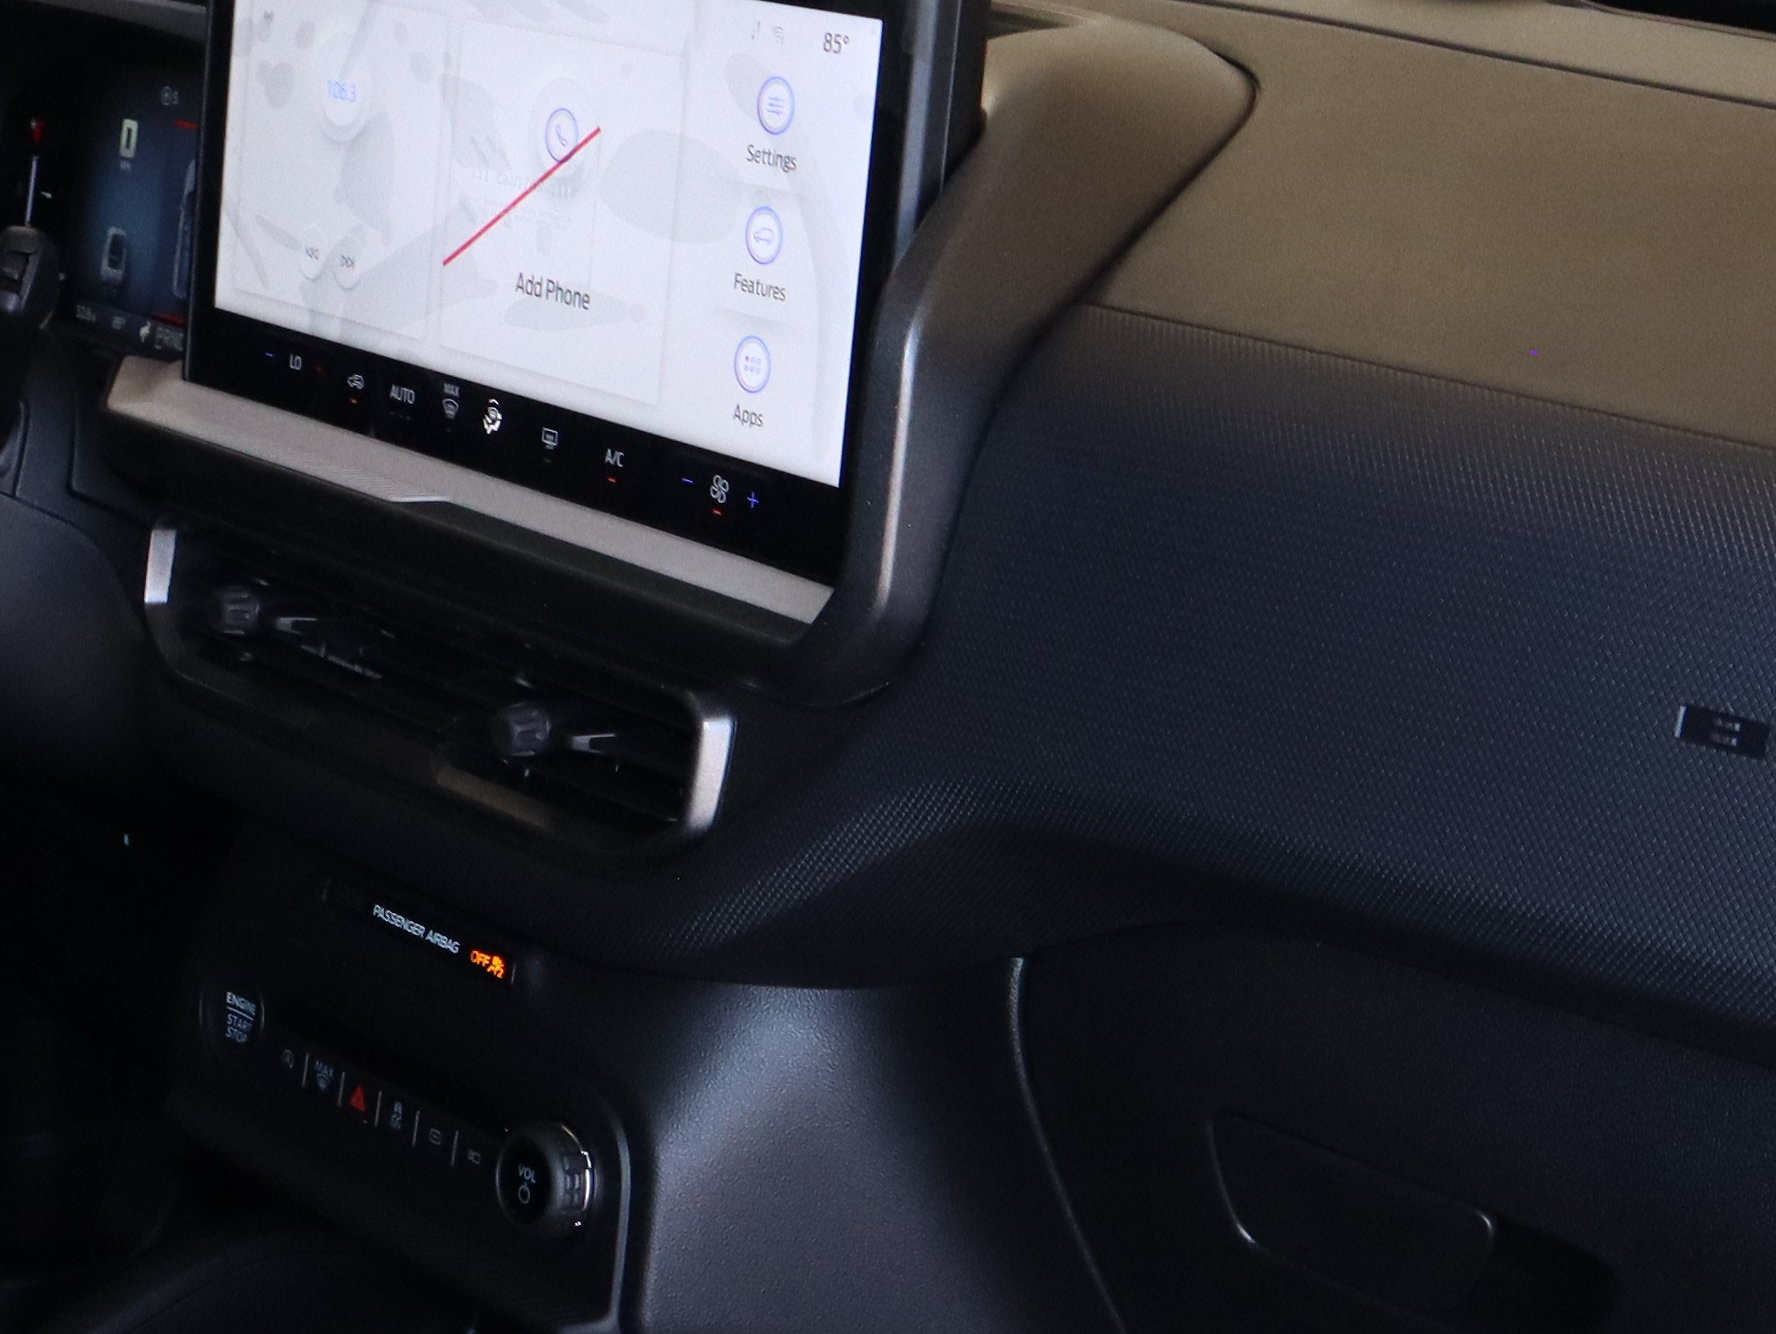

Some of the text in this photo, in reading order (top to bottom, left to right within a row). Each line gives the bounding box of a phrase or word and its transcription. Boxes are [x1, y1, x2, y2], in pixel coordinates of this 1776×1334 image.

[823, 30, 850, 55] 85°
[746, 144, 797, 173] Settings
[515, 271, 591, 311] Add Phone
[733, 273, 787, 302] Features
[389, 384, 416, 405] AUTO
[732, 404, 764, 430] Apps
[605, 447, 624, 468] A/C
[373, 903, 491, 968] PASSENGER AIRBAG OFF
[226, 991, 256, 1015] ENGINE
[518, 1164, 537, 1184] VOL
